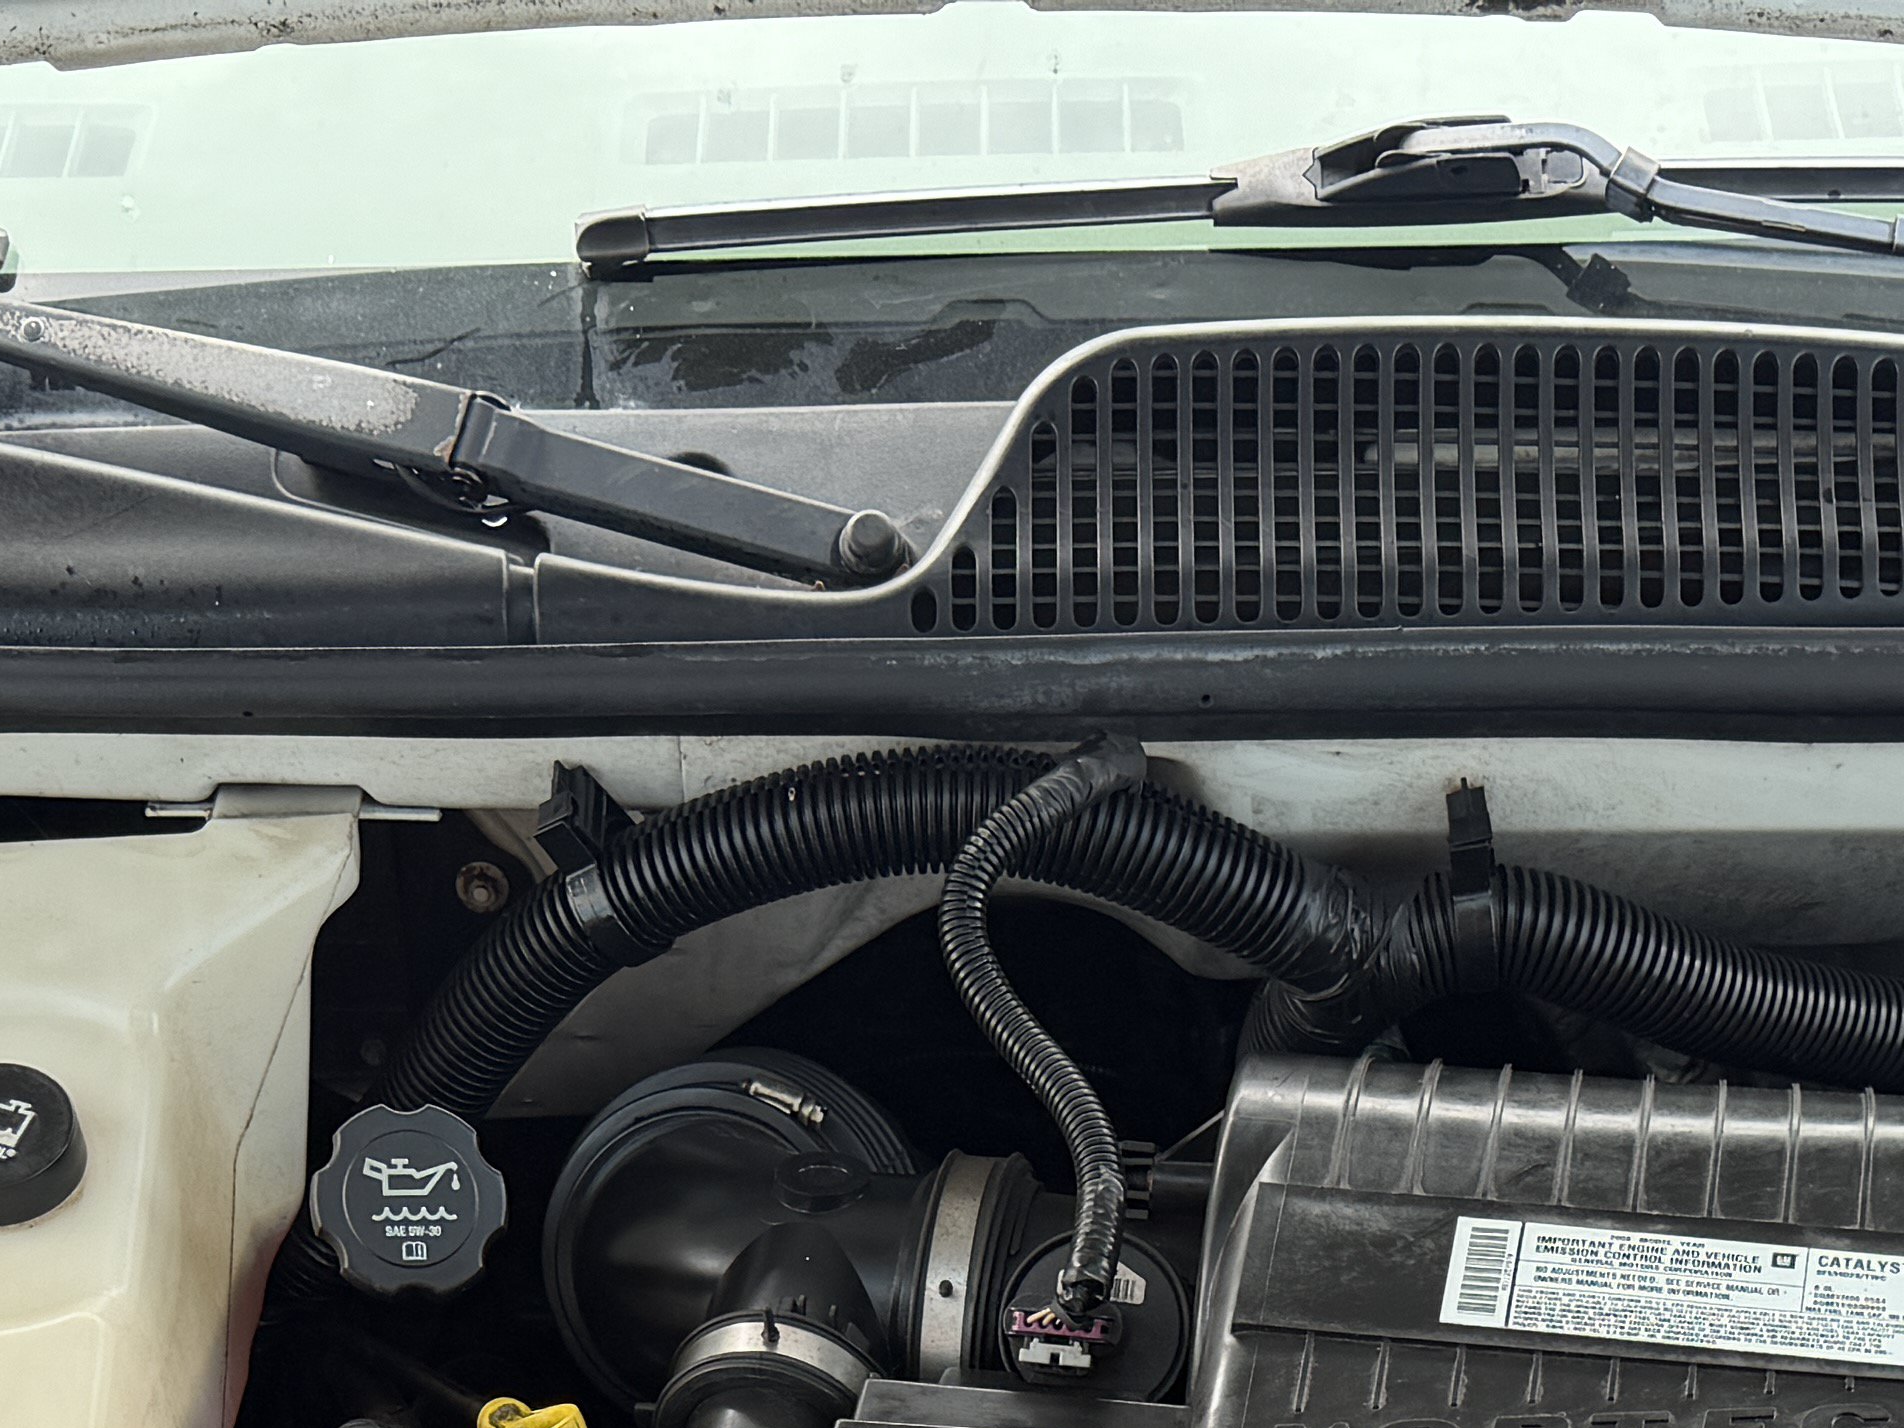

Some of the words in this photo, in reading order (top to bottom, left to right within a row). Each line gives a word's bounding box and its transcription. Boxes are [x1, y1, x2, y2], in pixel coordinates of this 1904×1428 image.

[385, 1225, 406, 1237] SAE
[408, 1225, 442, 1237] 5W-30
[1535, 1243, 1599, 1259] EMISSION
[1603, 1248, 1666, 1265] CONTROL
[1669, 1255, 1763, 1275] INFORMATION
[1536, 1235, 1614, 1252] IMPORTANT
[1618, 1242, 1669, 1257] ENGINE
[1672, 1247, 1701, 1260] AND
[1705, 1250, 1760, 1266] VEHICLE
[1550, 1266, 1617, 1281] ADJUSTMENTS
[1664, 1276, 1683, 1287] SEE
[1724, 1282, 1765, 1297] MANUAL
[1574, 1276, 1614, 1290] MANUAL
[1616, 1280, 1636, 1292] FOR
[1637, 1283, 1665, 1295] MORE
